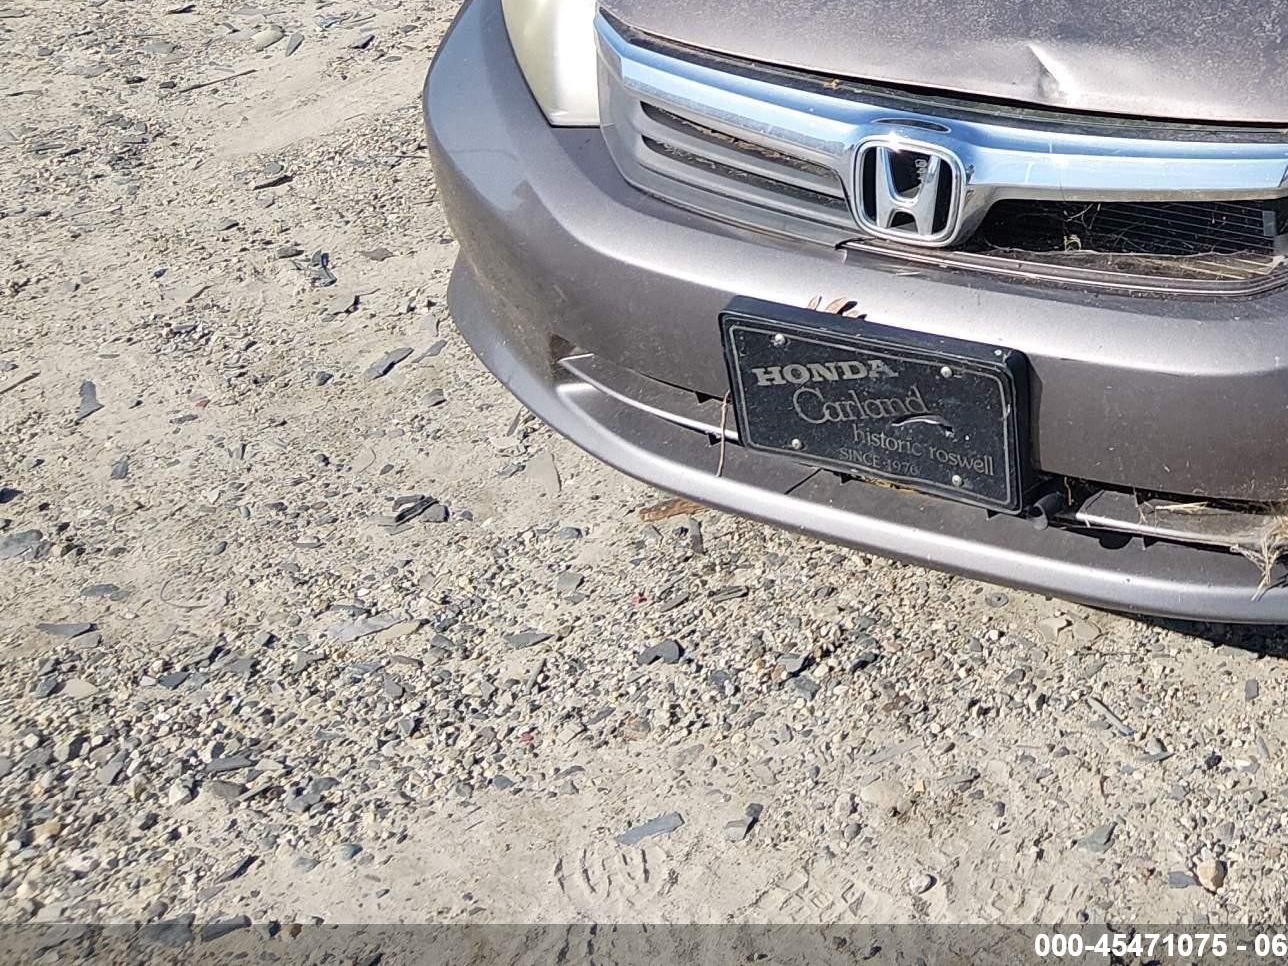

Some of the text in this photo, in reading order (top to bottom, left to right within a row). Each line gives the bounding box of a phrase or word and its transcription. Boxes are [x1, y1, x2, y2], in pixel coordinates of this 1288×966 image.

[752, 360, 897, 385] HONDA
[792, 386, 928, 424] Carland
[839, 448, 881, 470] SINCE
[853, 424, 994, 476] historic roswell
